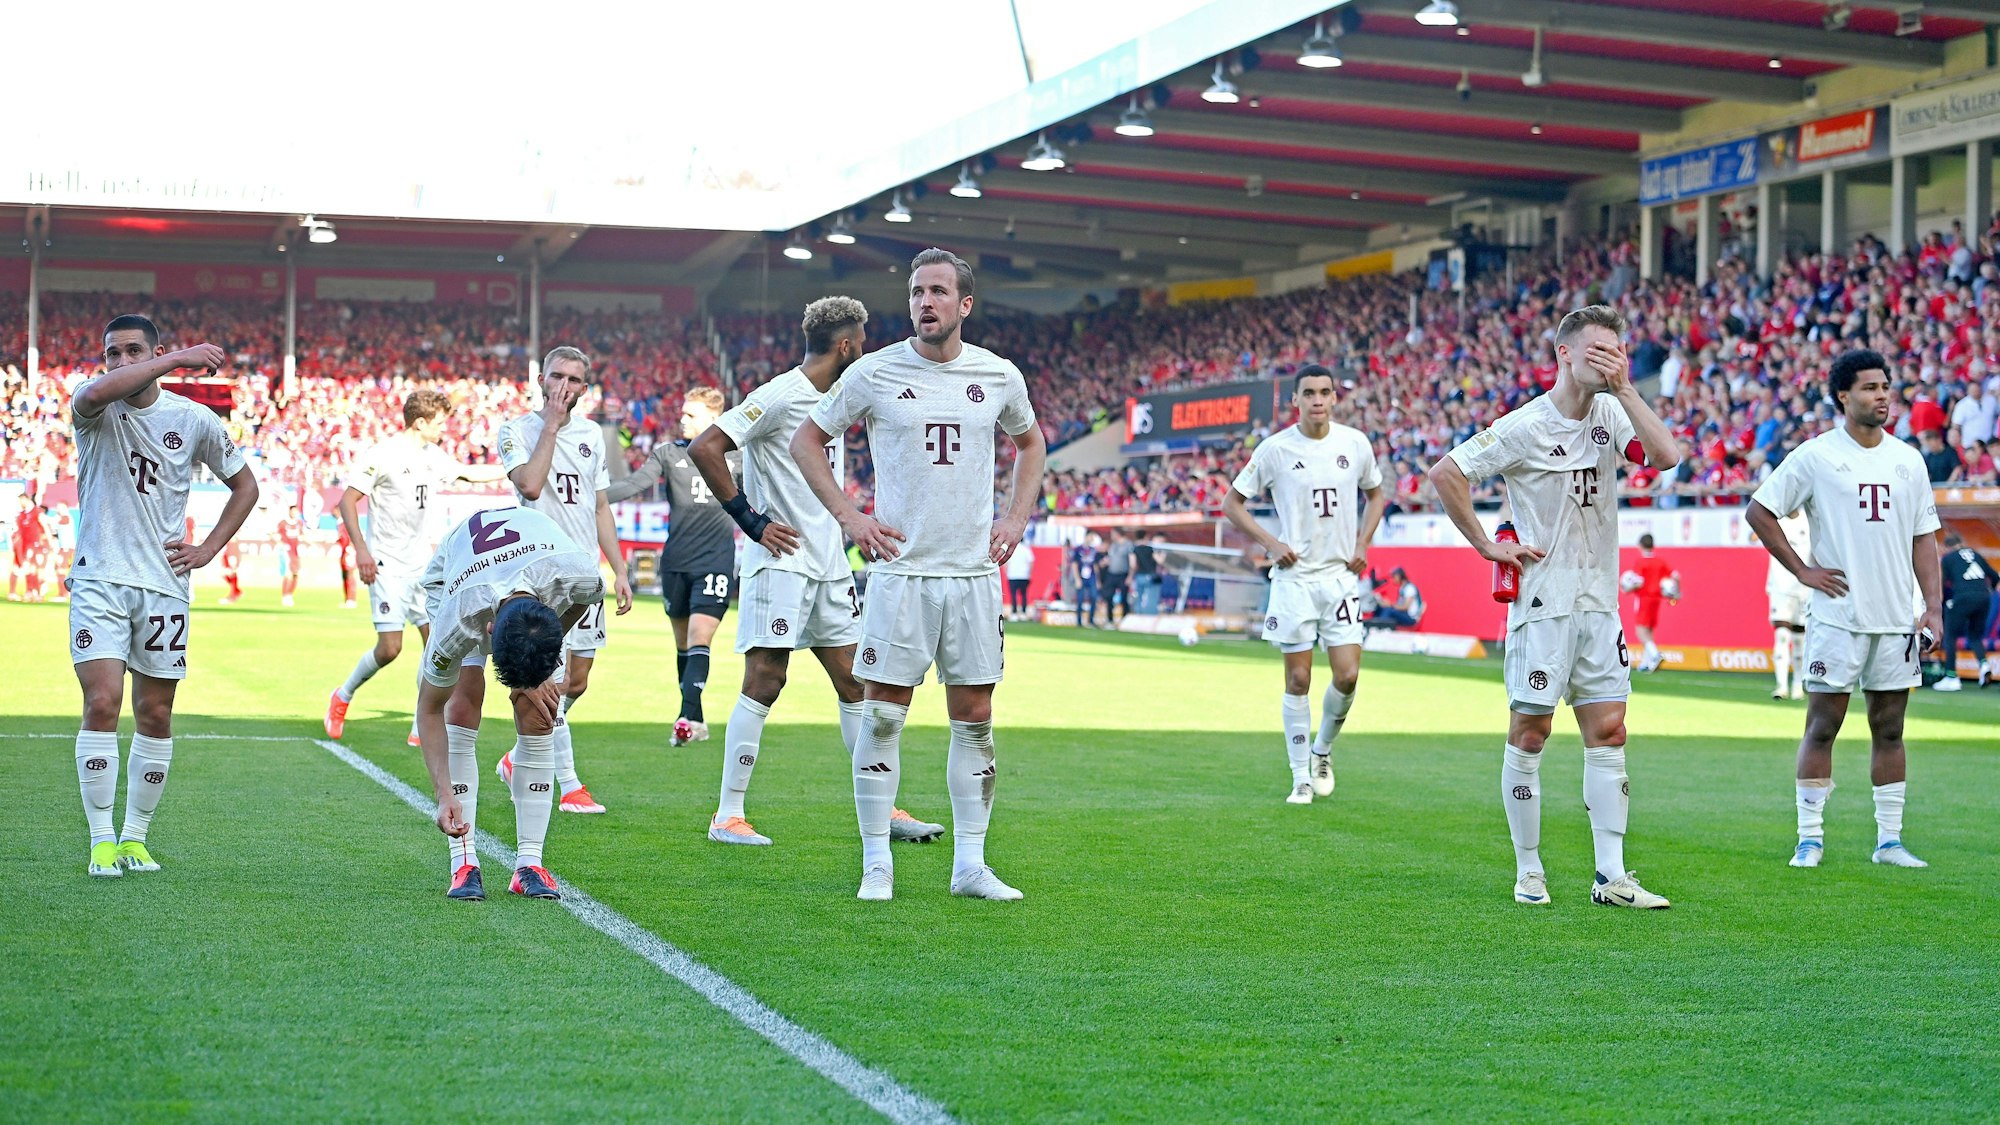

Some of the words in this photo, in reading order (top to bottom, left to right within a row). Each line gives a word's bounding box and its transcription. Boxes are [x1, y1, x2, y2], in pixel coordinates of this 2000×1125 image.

[1800, 113, 1873, 160] Hummel
[925, 423, 961, 465] T
[130, 451, 158, 495] T
[1574, 467, 1598, 507] T
[416, 484, 428, 509] T
[556, 473, 580, 505] T
[1312, 488, 1338, 518] T
[1858, 483, 1890, 522] T
[493, 543, 536, 566] BAYERN
[540, 543, 555, 551] FC
[448, 558, 490, 596] MÜNCHEN
[702, 573, 729, 598] 18
[1501, 562, 1514, 590] Coca-Co
[577, 599, 604, 629] 27
[144, 614, 186, 651] 22
[1902, 633, 1915, 663] 7
[1616, 629, 1629, 668] 6
[1710, 651, 1768, 669] roma
